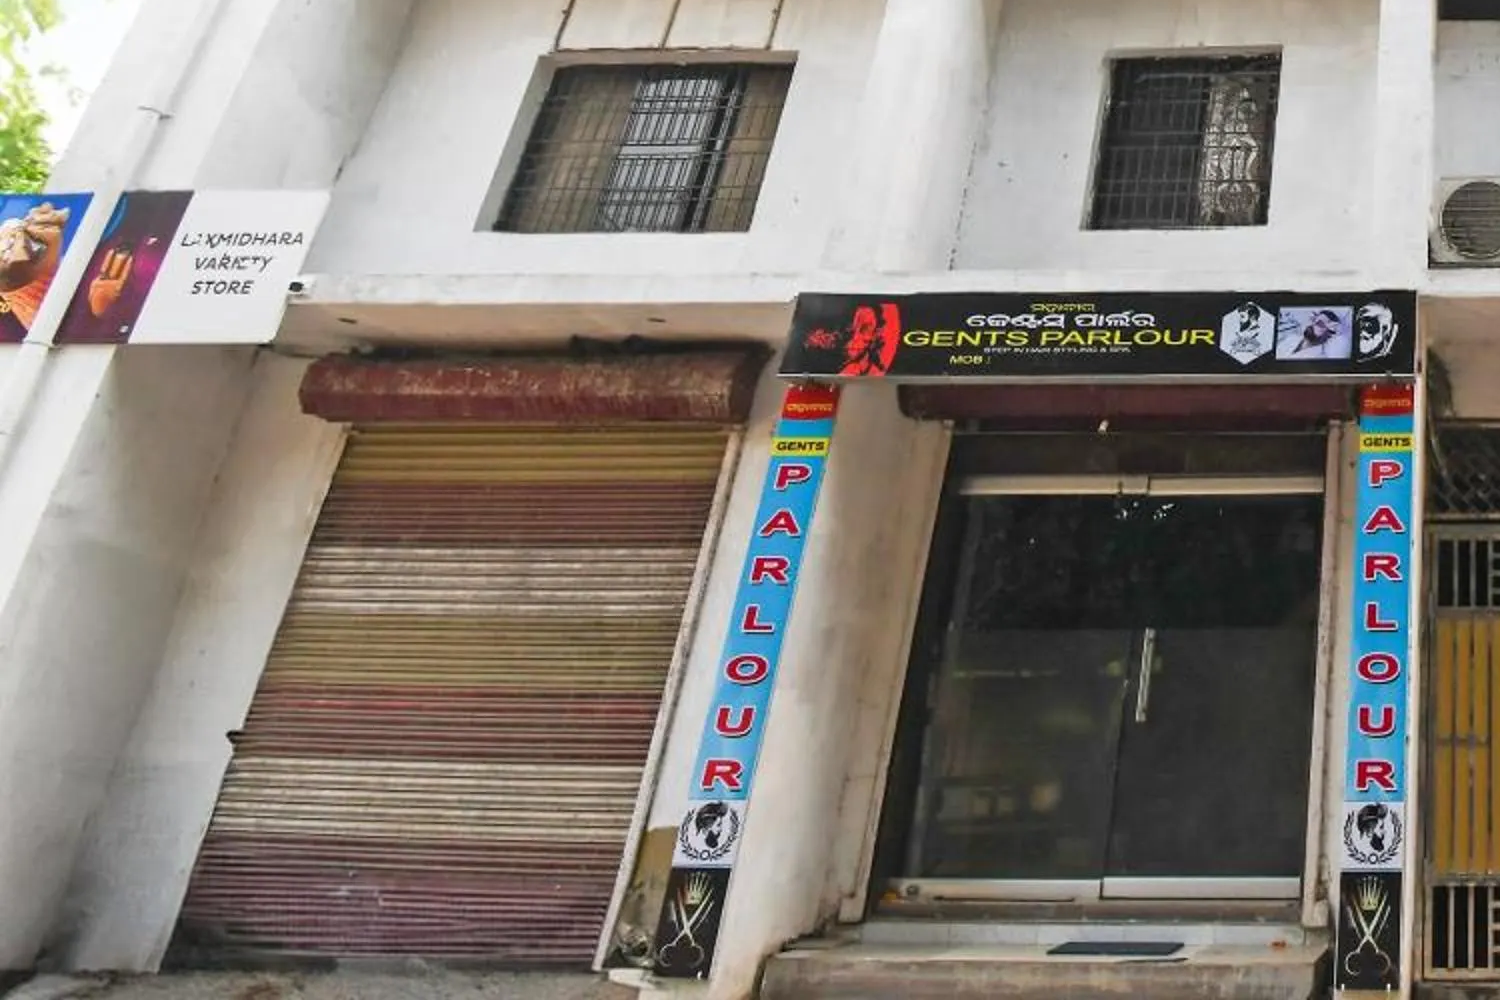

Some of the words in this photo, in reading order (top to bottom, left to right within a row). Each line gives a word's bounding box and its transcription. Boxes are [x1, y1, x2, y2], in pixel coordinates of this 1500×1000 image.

[195, 253, 273, 272] VARIETY
[191, 280, 255, 295] STORE
[902, 330, 1029, 347] GENTS
[1040, 328, 1216, 346] PARLOUR
[949, 355, 983, 365] MOB
[776, 440, 826, 451] GENTS
[1363, 436, 1411, 447] GENTS
[701, 463, 812, 791] PARLOUR
[1355, 459, 1404, 791] PARLOUR
